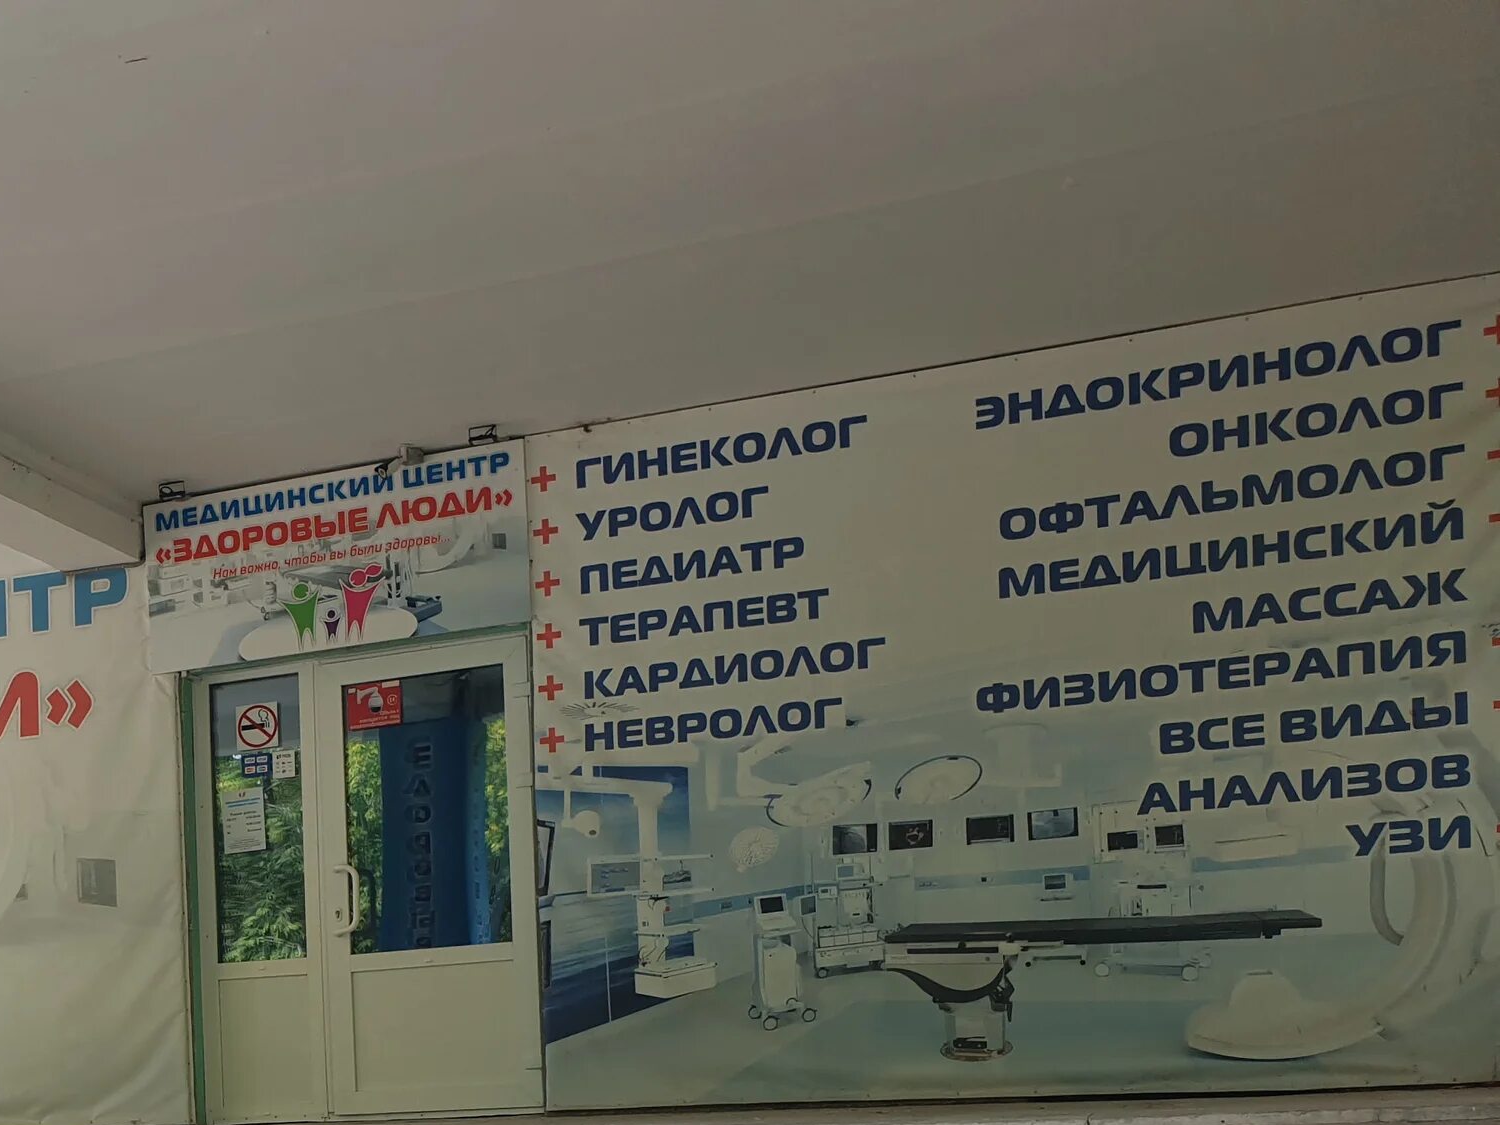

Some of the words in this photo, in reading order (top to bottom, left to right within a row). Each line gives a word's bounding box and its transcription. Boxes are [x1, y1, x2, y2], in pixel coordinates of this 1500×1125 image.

[975, 319, 1461, 430] ЭНДОКРИНОЛОГ
[1169, 381, 1464, 457] ОНКОЛОГ
[576, 414, 868, 489] ГИНЕКОЛОГ
[155, 474, 393, 532] МЕДИЦИНСКИЙ
[402, 453, 510, 489] ЦЕНТР
[575, 485, 769, 541] УРОЛОГ
[999, 443, 1465, 541] ОФТАЛЬМОЛОГ
[155, 507, 369, 566] «ЗДОРОВЫЕ
[376, 486, 513, 529] ЛЮДИ»
[998, 499, 1464, 600] МЕДИЦИНСКИЙ
[213, 567, 237, 579] Нам
[240, 560, 281, 575] важно,
[284, 552, 326, 568] чтобы
[329, 549, 346, 560] вы
[350, 543, 380, 557] были
[580, 536, 804, 595] ПЕДИАТР
[579, 588, 829, 646] ТЕРАПЕВТ
[1193, 568, 1468, 634] МАССАЖ
[584, 637, 886, 700] КАРДИОЛОГ
[976, 630, 1466, 713] ФИЗИОТЕРАПИЯ
[584, 697, 843, 752] НЕВРОЛОГ
[1159, 713, 1266, 755] ВСЕ
[1280, 692, 1469, 744] ВИДЫ
[1137, 754, 1471, 816] АНАЛИЗОВ
[1345, 815, 1472, 857] УЗИ
